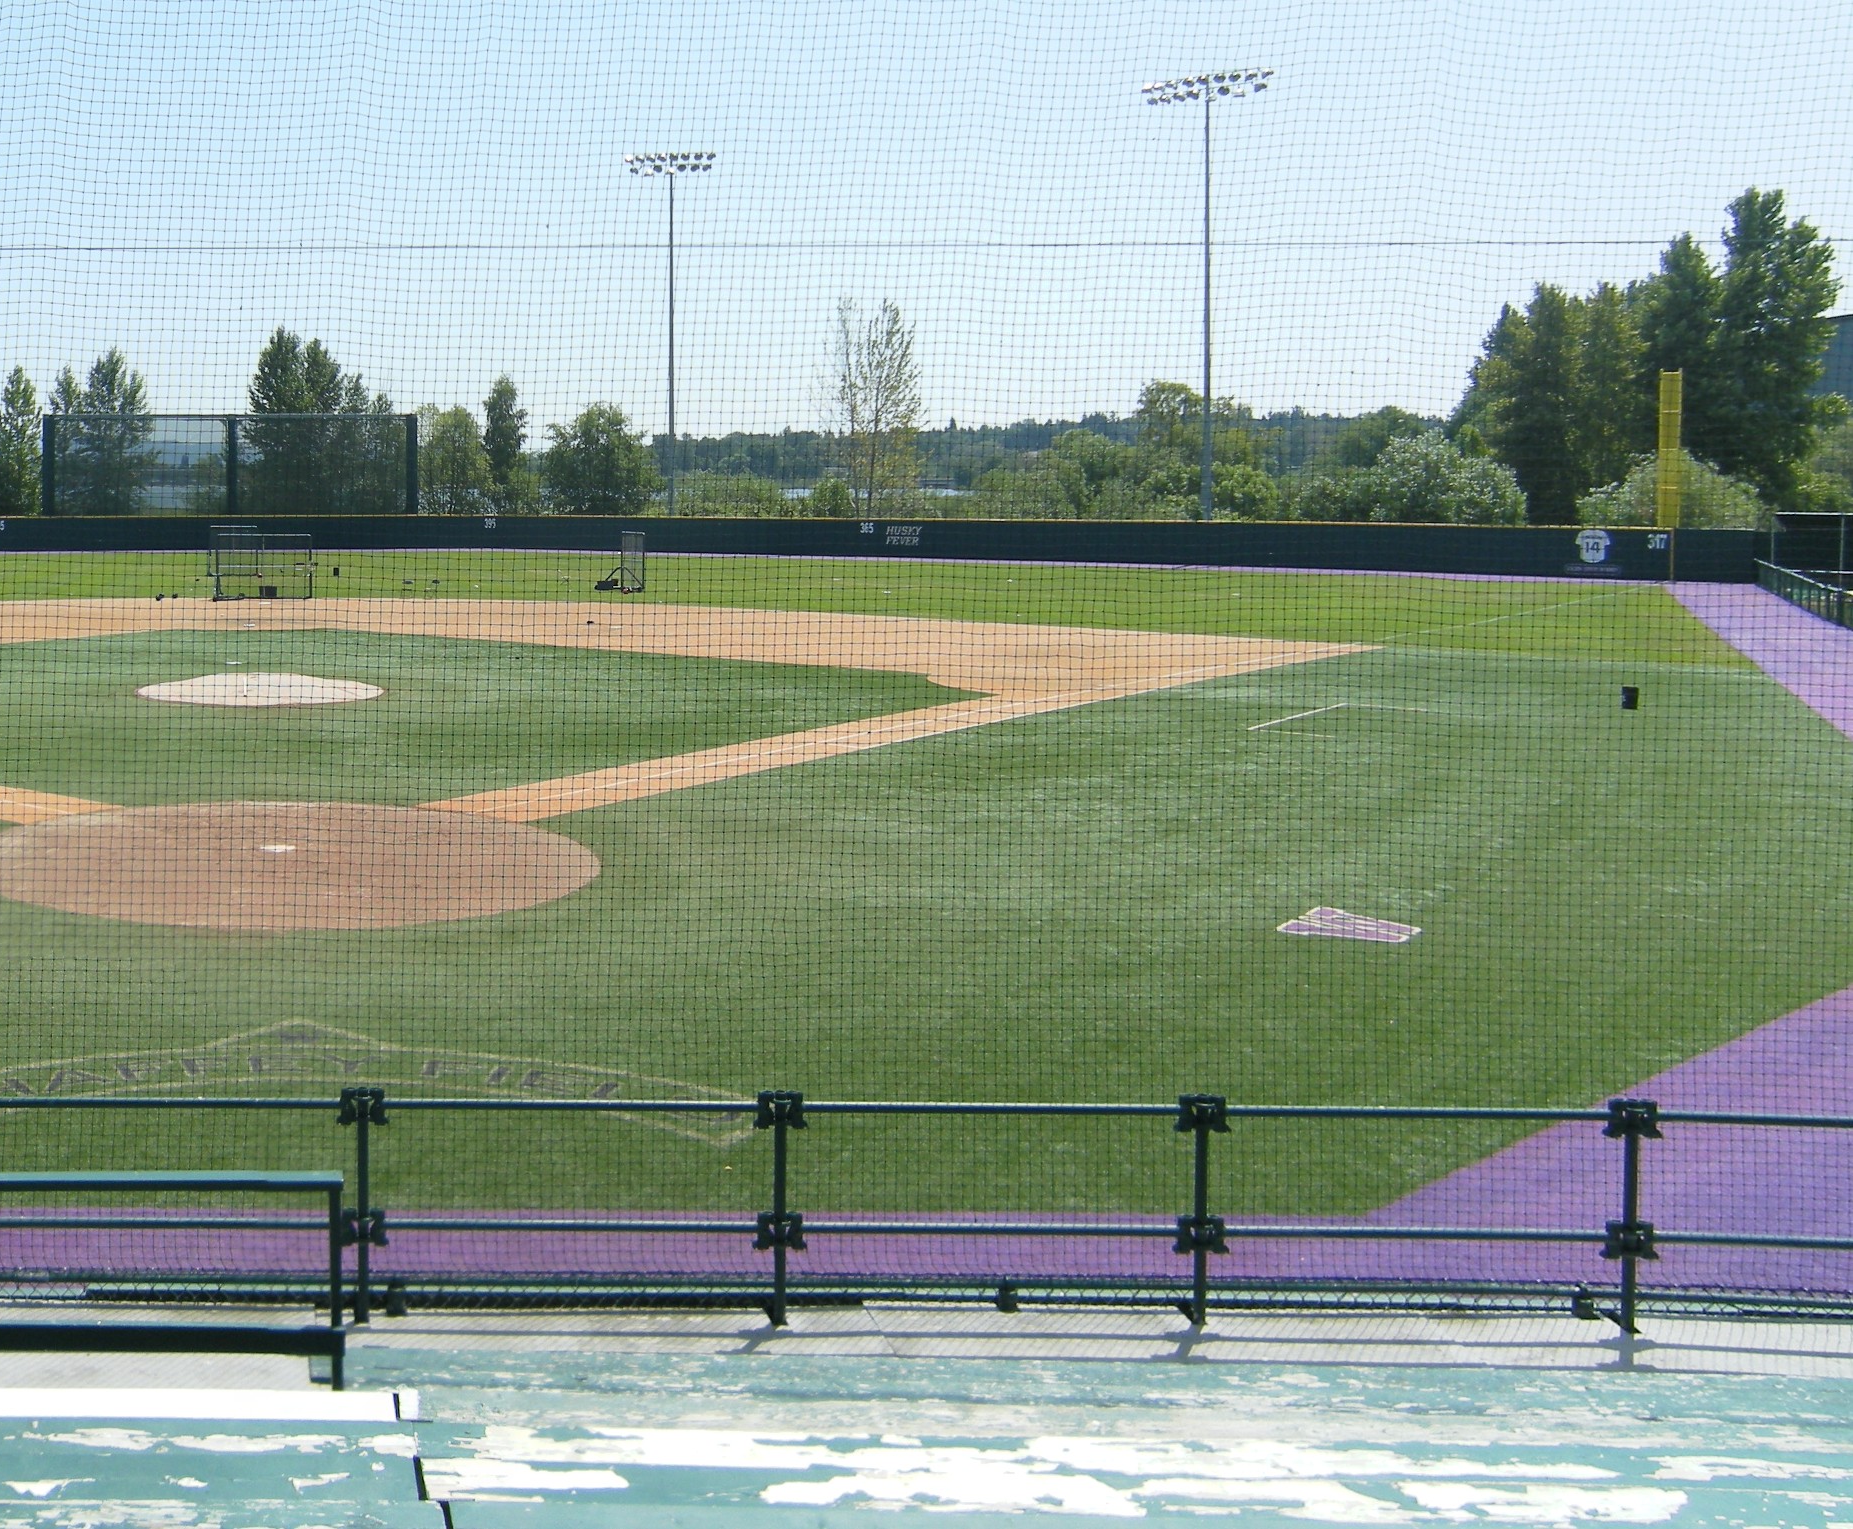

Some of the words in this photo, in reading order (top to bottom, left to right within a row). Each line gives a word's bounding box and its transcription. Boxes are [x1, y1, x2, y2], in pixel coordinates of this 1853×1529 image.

[859, 522, 874, 534] 365
[886, 526, 922, 535] HUSKY
[886, 536, 920, 545] FEVER
[1647, 533, 1668, 549] 317
[1585, 541, 1601, 554] 14
